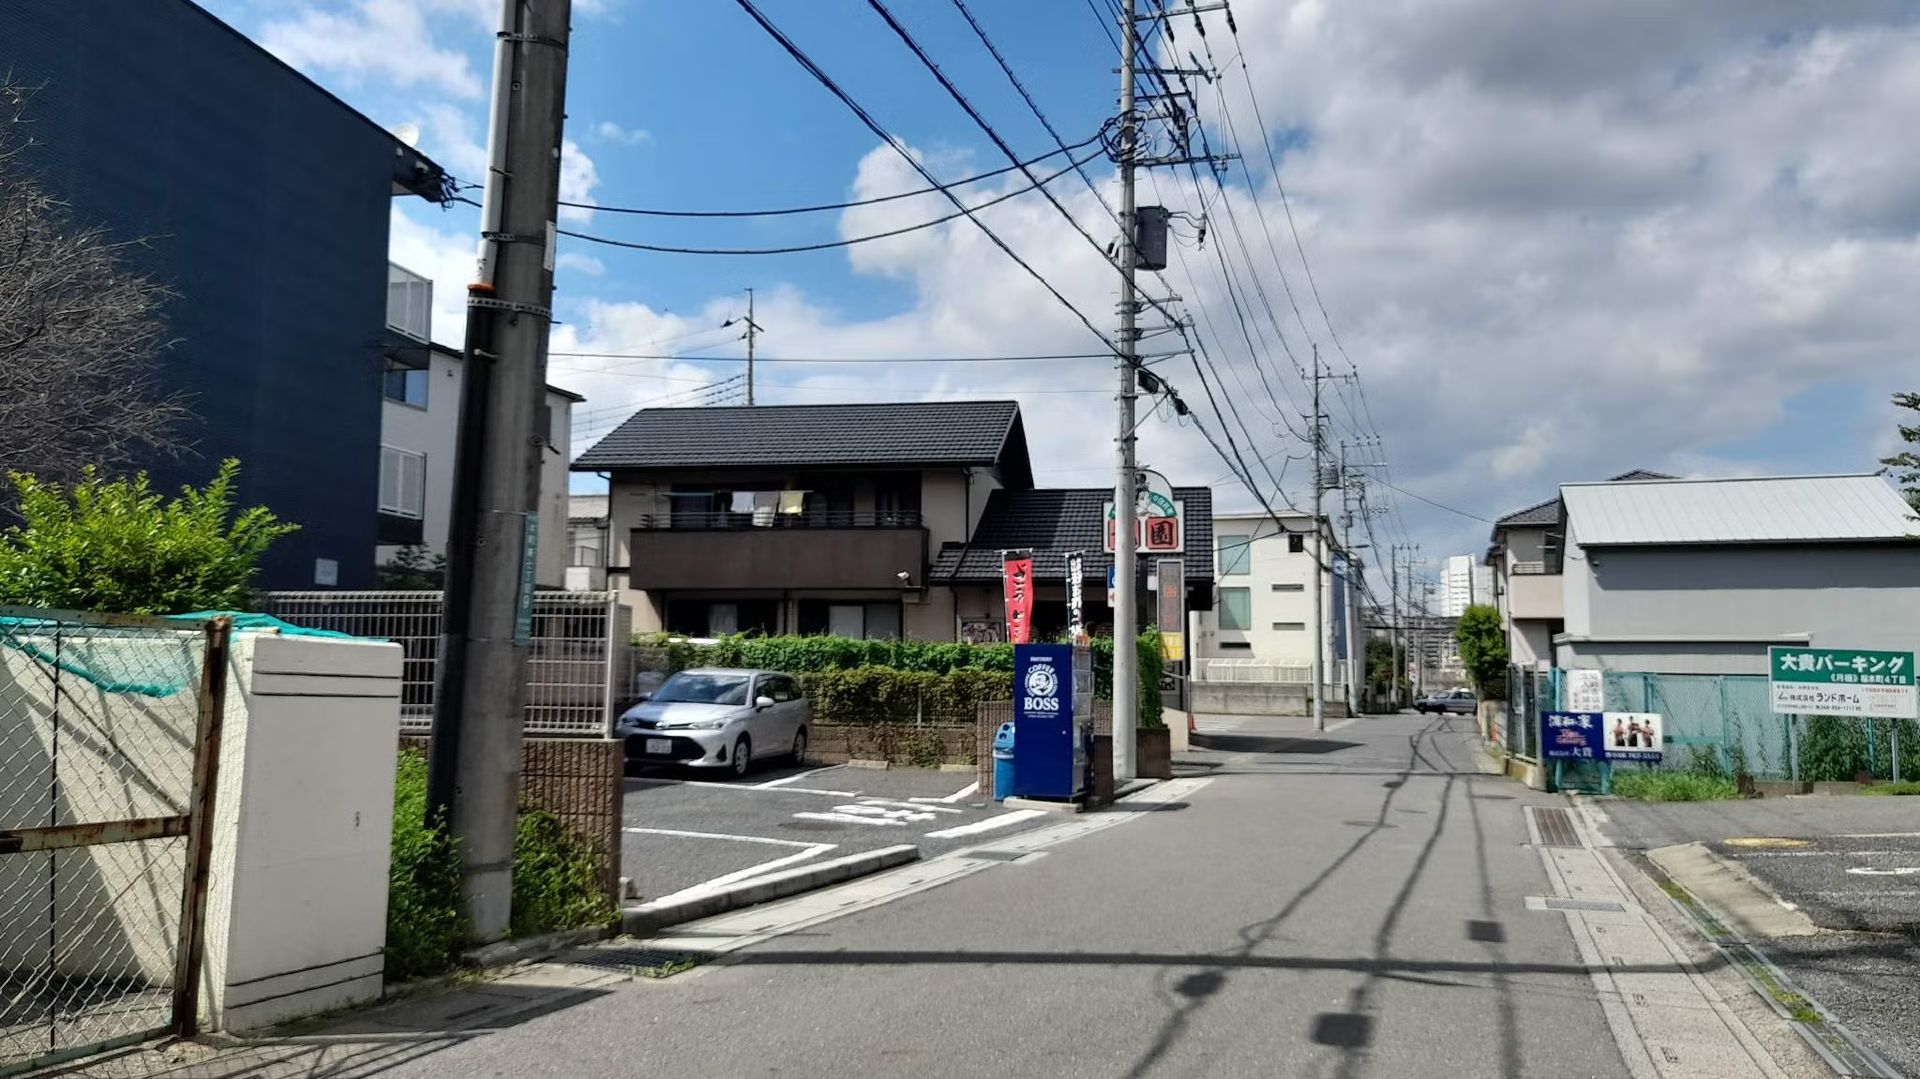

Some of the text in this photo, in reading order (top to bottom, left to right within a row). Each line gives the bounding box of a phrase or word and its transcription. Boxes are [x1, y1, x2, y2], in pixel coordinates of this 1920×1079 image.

[1028, 663, 1055, 674] COFFEE
[1780, 653, 1905, 674] 大貴パーキング
[1024, 697, 1059, 711] BOSS
